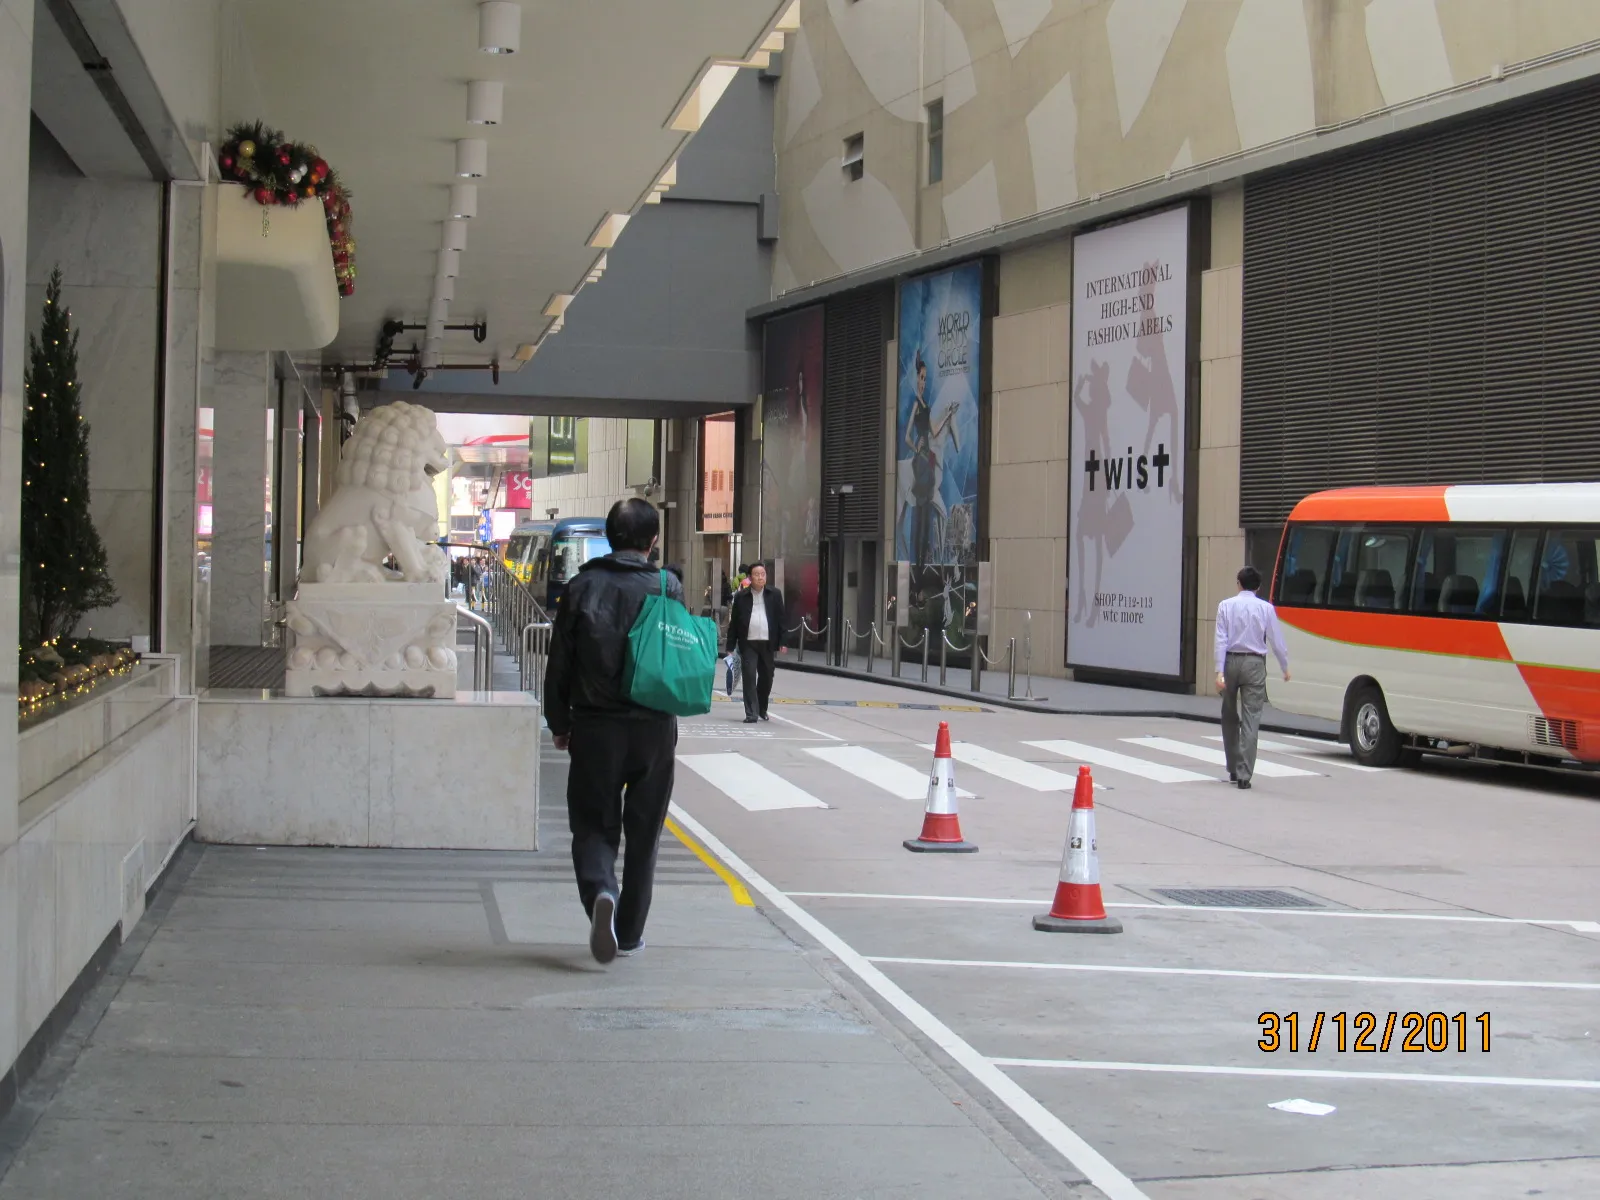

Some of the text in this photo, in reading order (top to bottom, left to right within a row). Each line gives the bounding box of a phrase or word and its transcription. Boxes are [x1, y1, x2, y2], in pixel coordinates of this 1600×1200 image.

[1086, 263, 1173, 299] INTERNATIONAL
[1100, 293, 1155, 320] HIGH-END
[938, 311, 970, 332] WORLD
[1086, 314, 1173, 347] FASHION LABELS
[1085, 443, 1170, 492] twist
[1094, 592, 1117, 607] SHOP
[1103, 609, 1144, 624] wtc more
